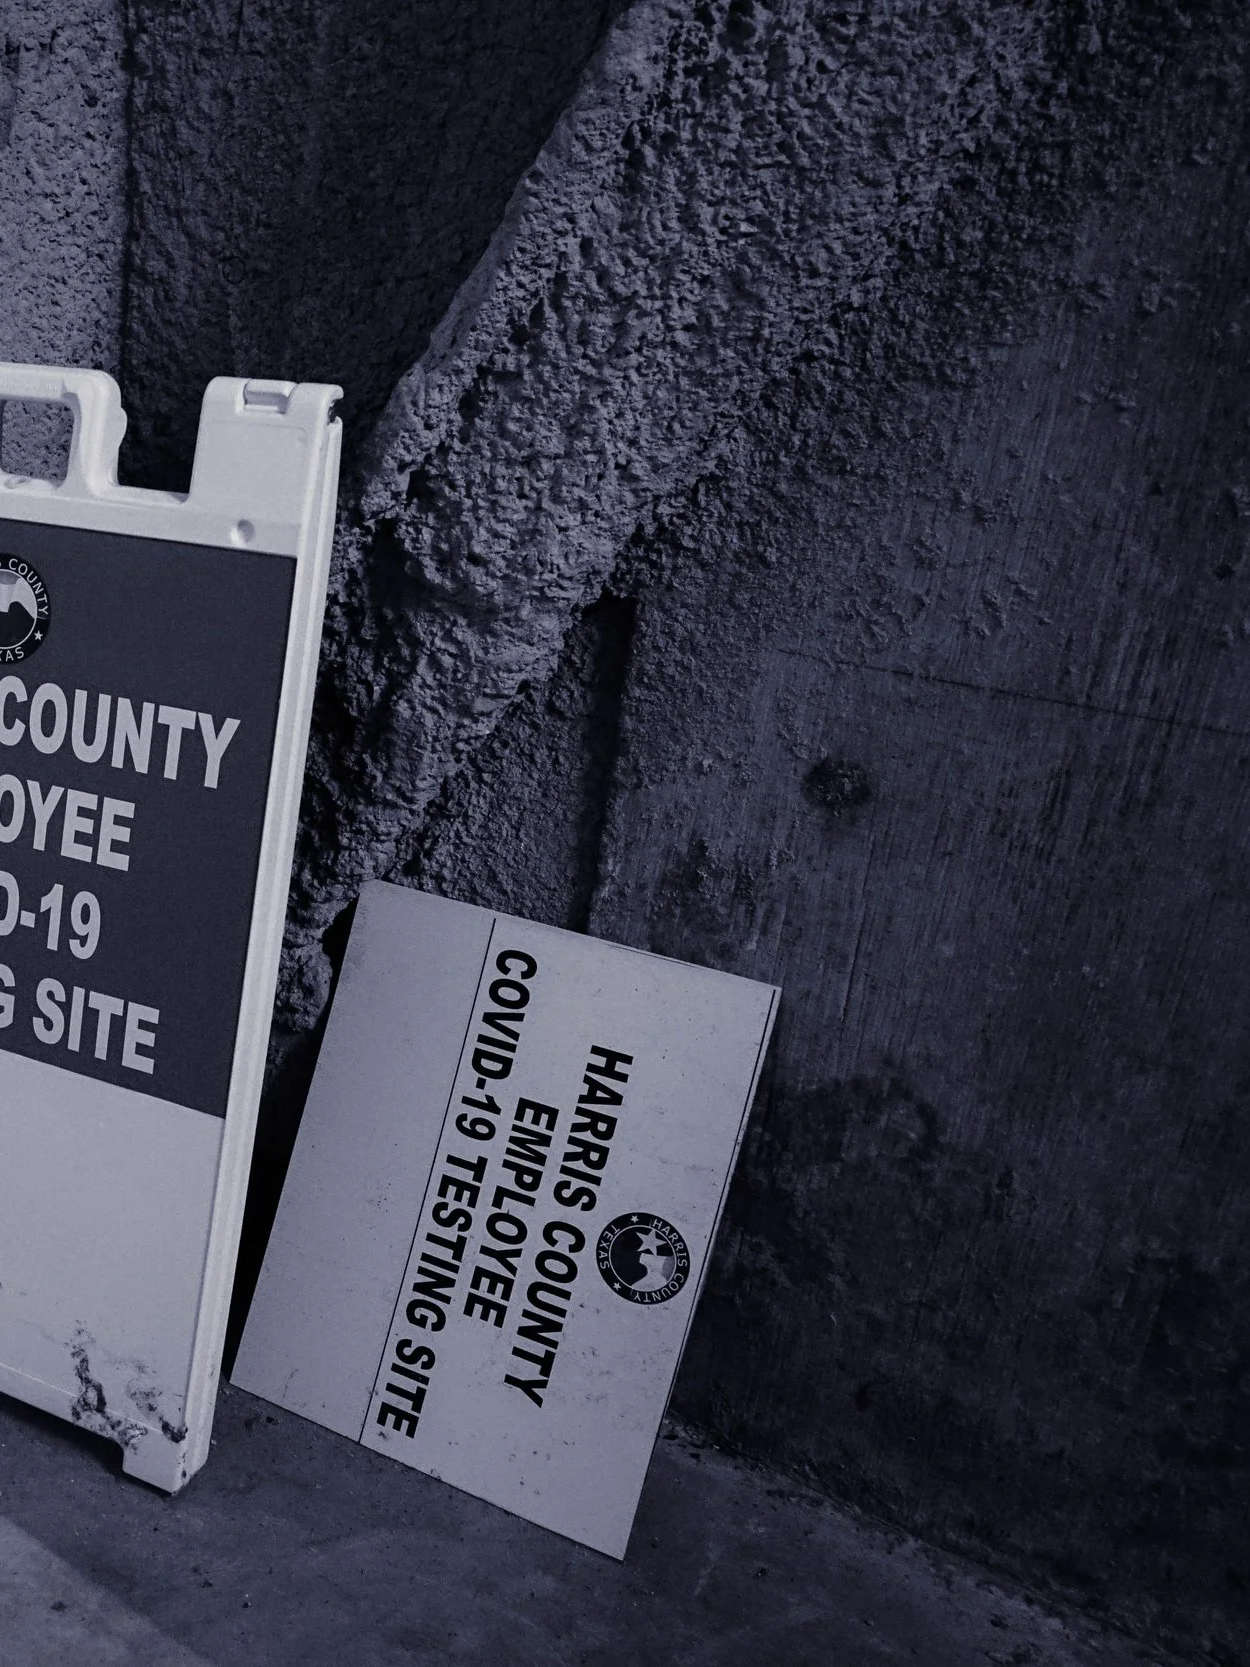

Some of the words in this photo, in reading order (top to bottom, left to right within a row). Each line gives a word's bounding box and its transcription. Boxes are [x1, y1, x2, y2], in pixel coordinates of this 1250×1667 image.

[8, 558, 49, 615] COUNTY
[32, 977, 160, 1075] SITE
[455, 949, 538, 1142] COVID-19
[553, 1044, 634, 1212] HARRIS
[405, 1153, 489, 1332] TESTING
[462, 1096, 560, 1329] EMPLOYEE
[598, 1224, 621, 1270] TEXAS
[652, 1218, 688, 1268] HARRIS
[503, 1220, 586, 1409] COUNTY
[633, 1272, 685, 1303] COUNTY
[376, 1338, 436, 1439] SITE
